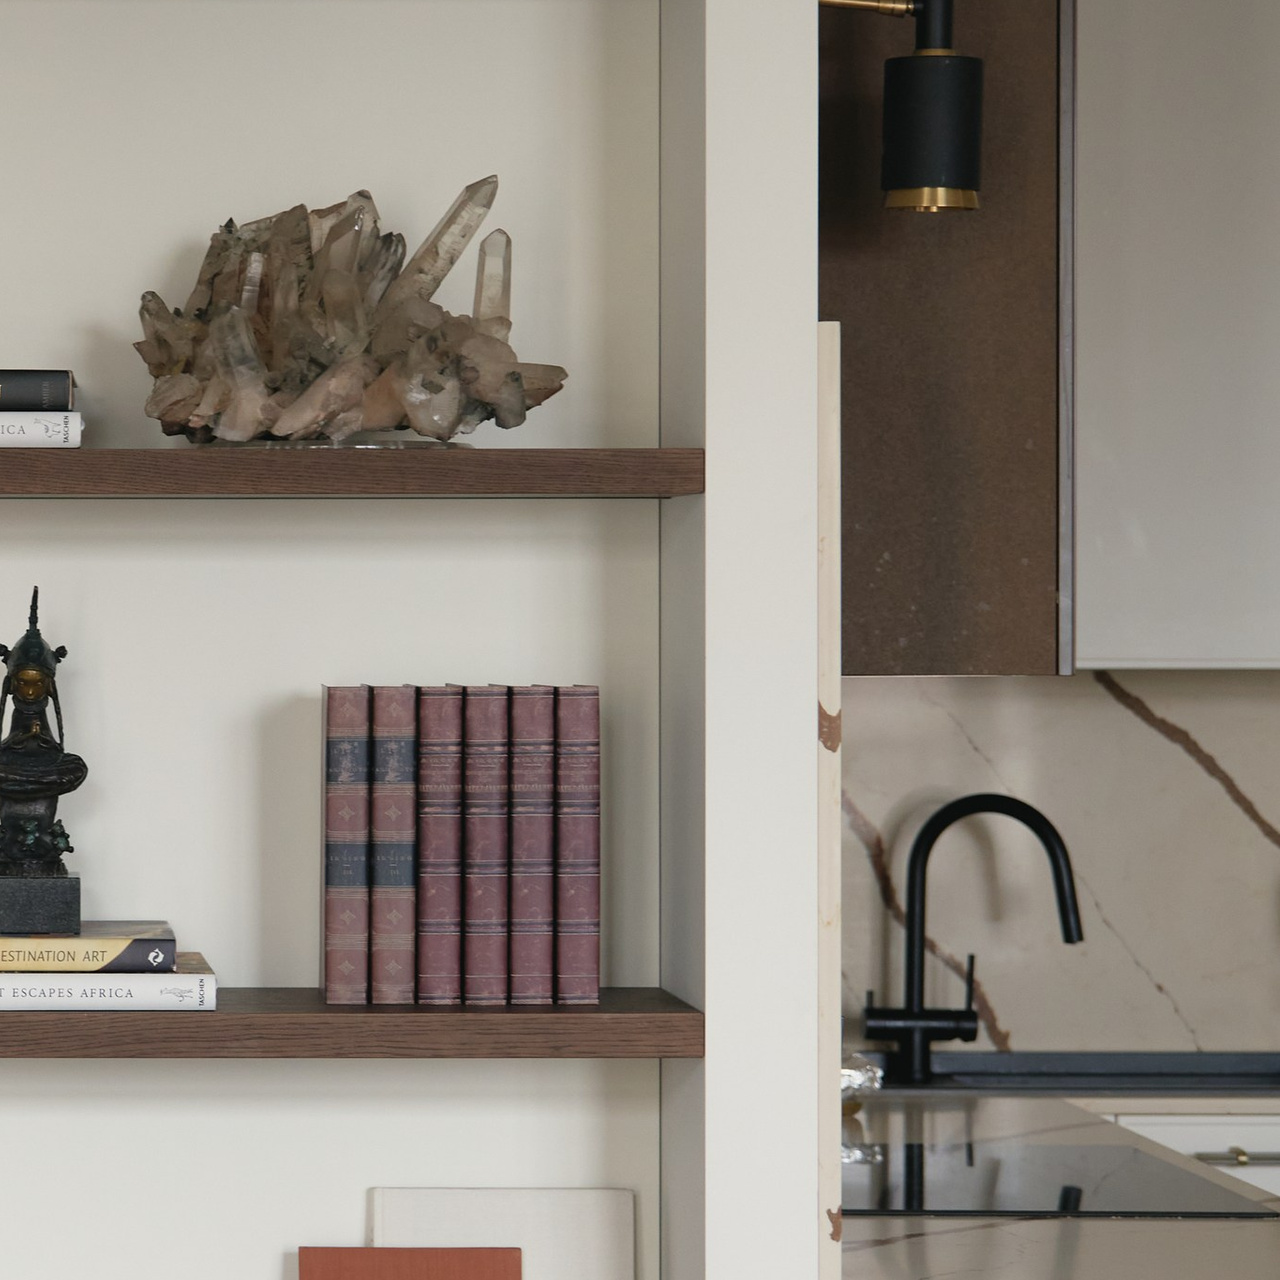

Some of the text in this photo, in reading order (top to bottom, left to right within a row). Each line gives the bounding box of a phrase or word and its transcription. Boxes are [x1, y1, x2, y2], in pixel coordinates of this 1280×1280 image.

[83, 950, 108, 962] ART
[12, 987, 73, 998] ESCAPES
[80, 988, 134, 998] AFRICA
